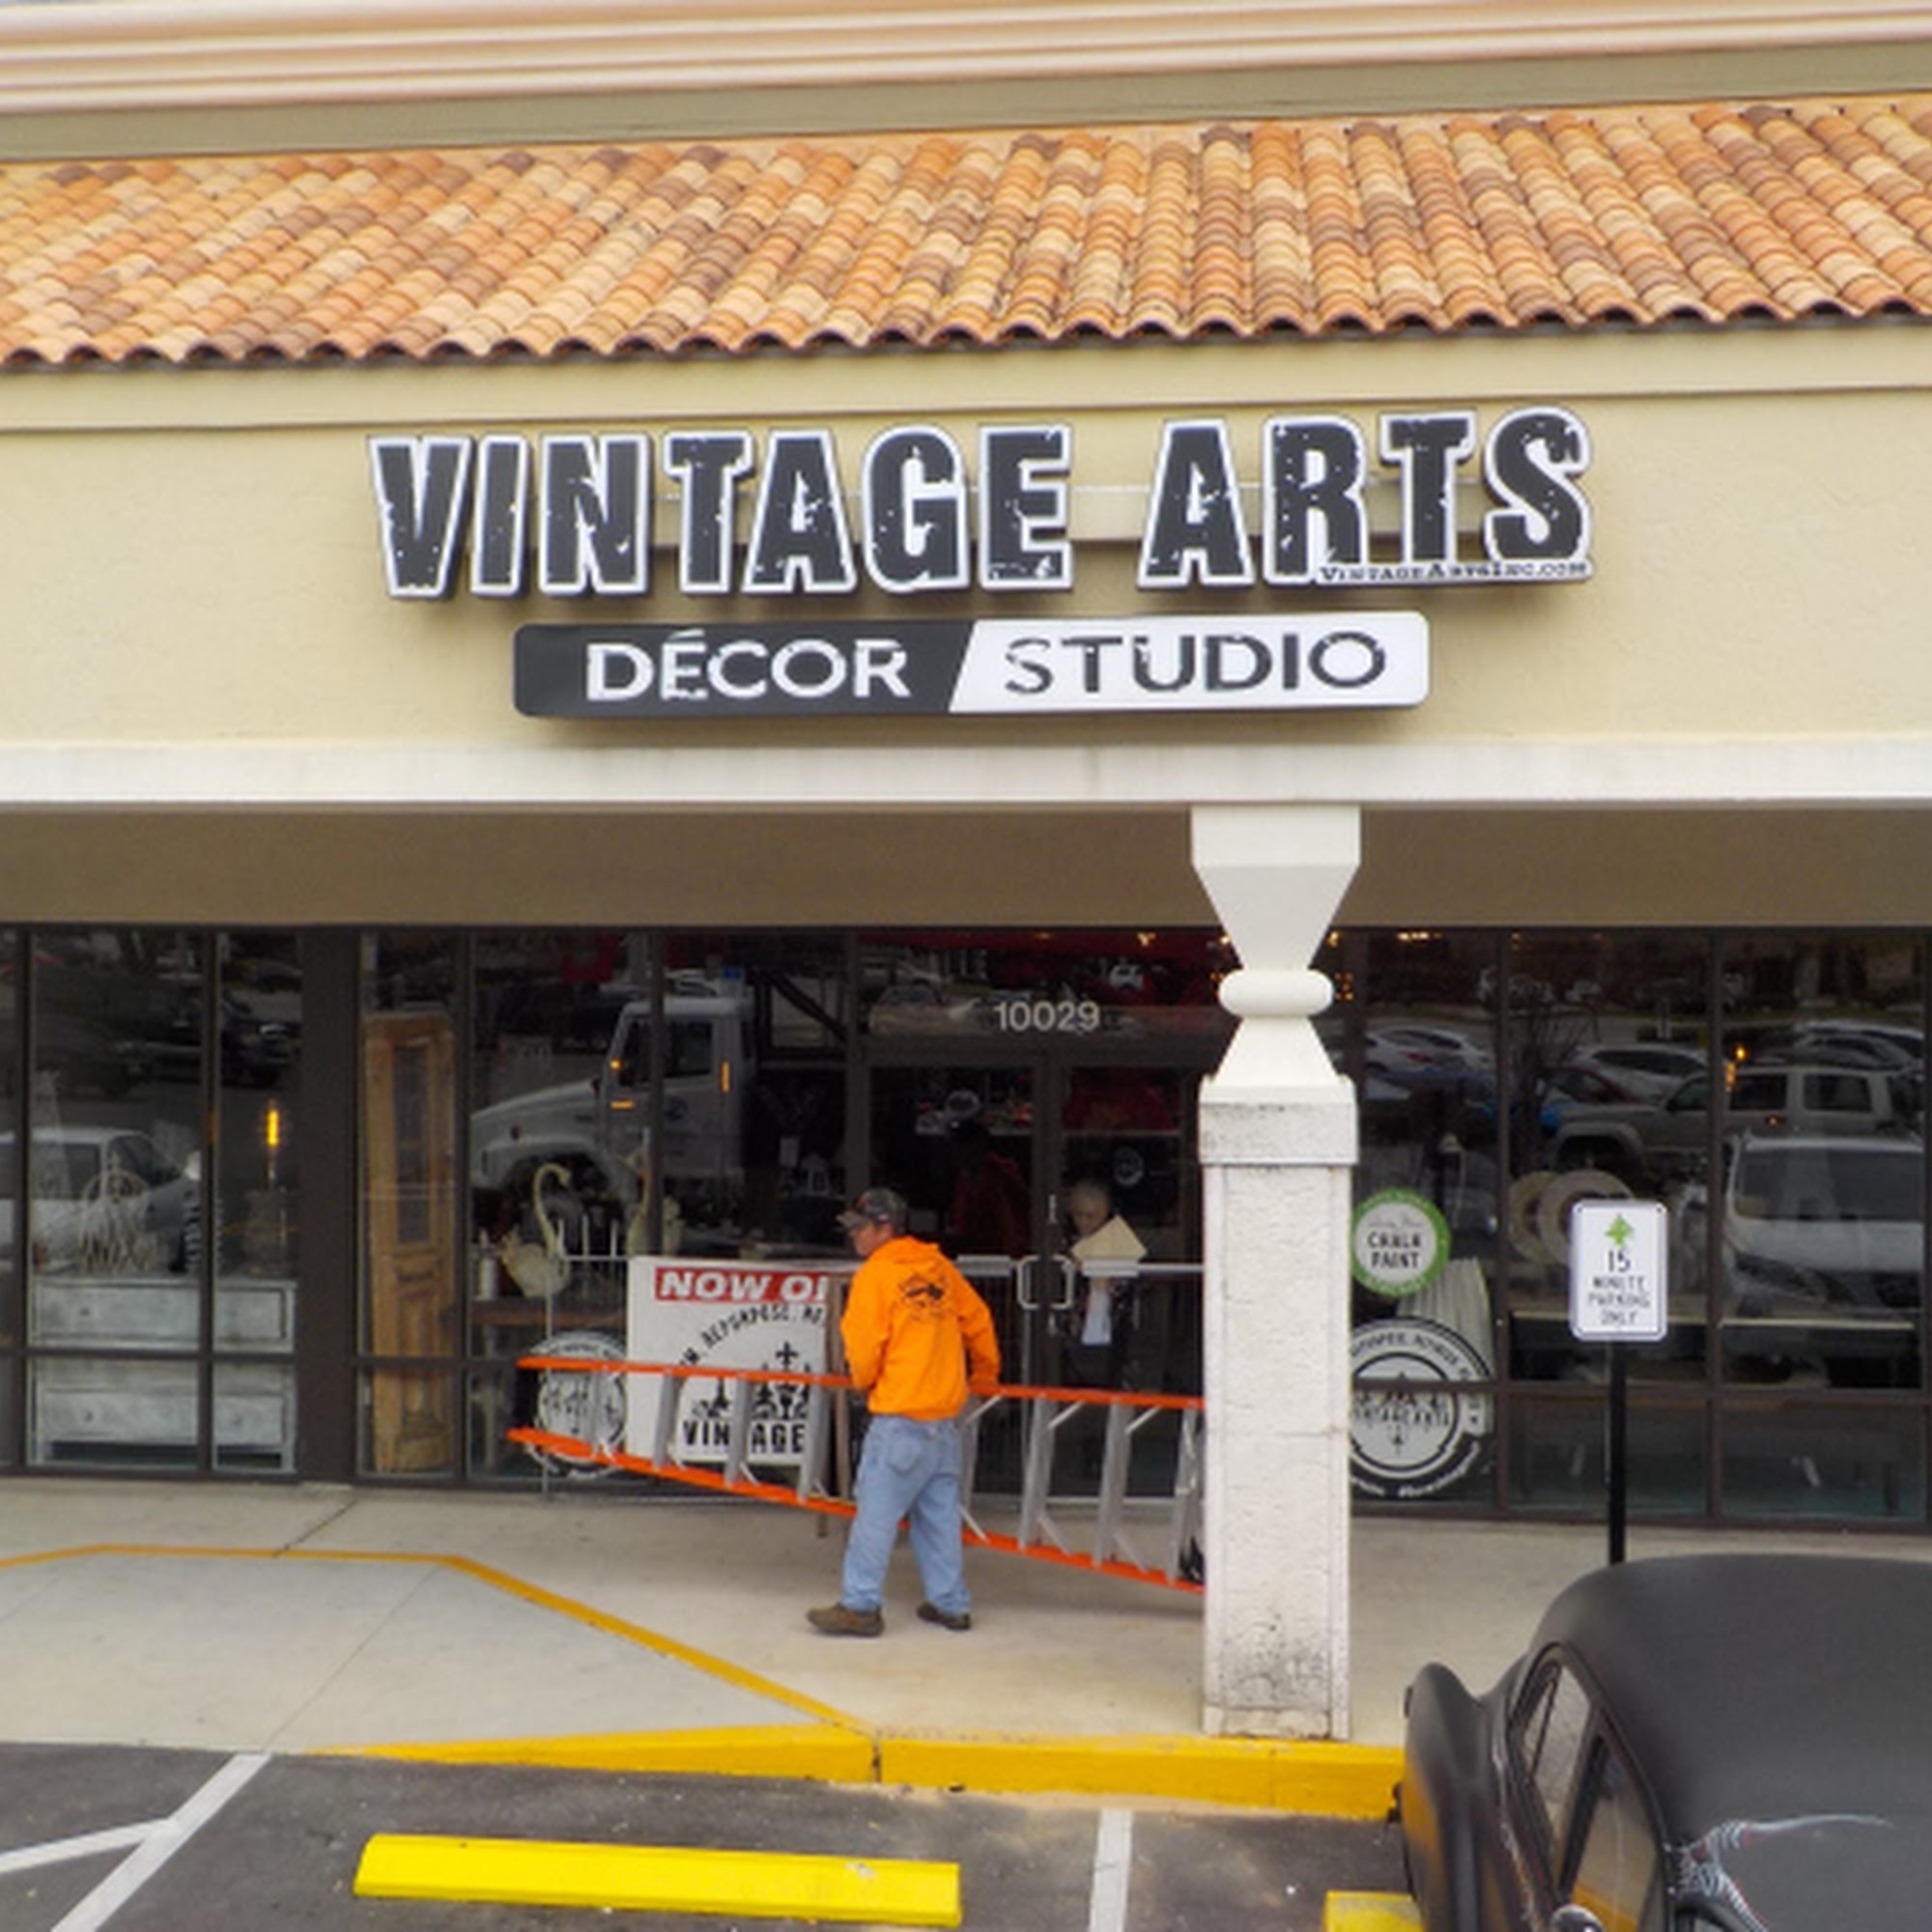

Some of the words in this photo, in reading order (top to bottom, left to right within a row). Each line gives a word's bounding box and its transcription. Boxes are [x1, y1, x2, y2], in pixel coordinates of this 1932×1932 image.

[369, 425, 1072, 598] VINTAGE
[1138, 407, 1592, 587] ARTS
[585, 629, 911, 702] DÉCOR
[1004, 630, 1388, 696] STUDIO
[993, 1001, 1101, 1032] 10029
[1367, 1232, 1421, 1248] CHALK
[1372, 1251, 1419, 1268] PAINT
[1608, 1249, 1631, 1272] 15
[659, 1270, 773, 1300] NOW
[682, 1419, 807, 1454] VINAGE
